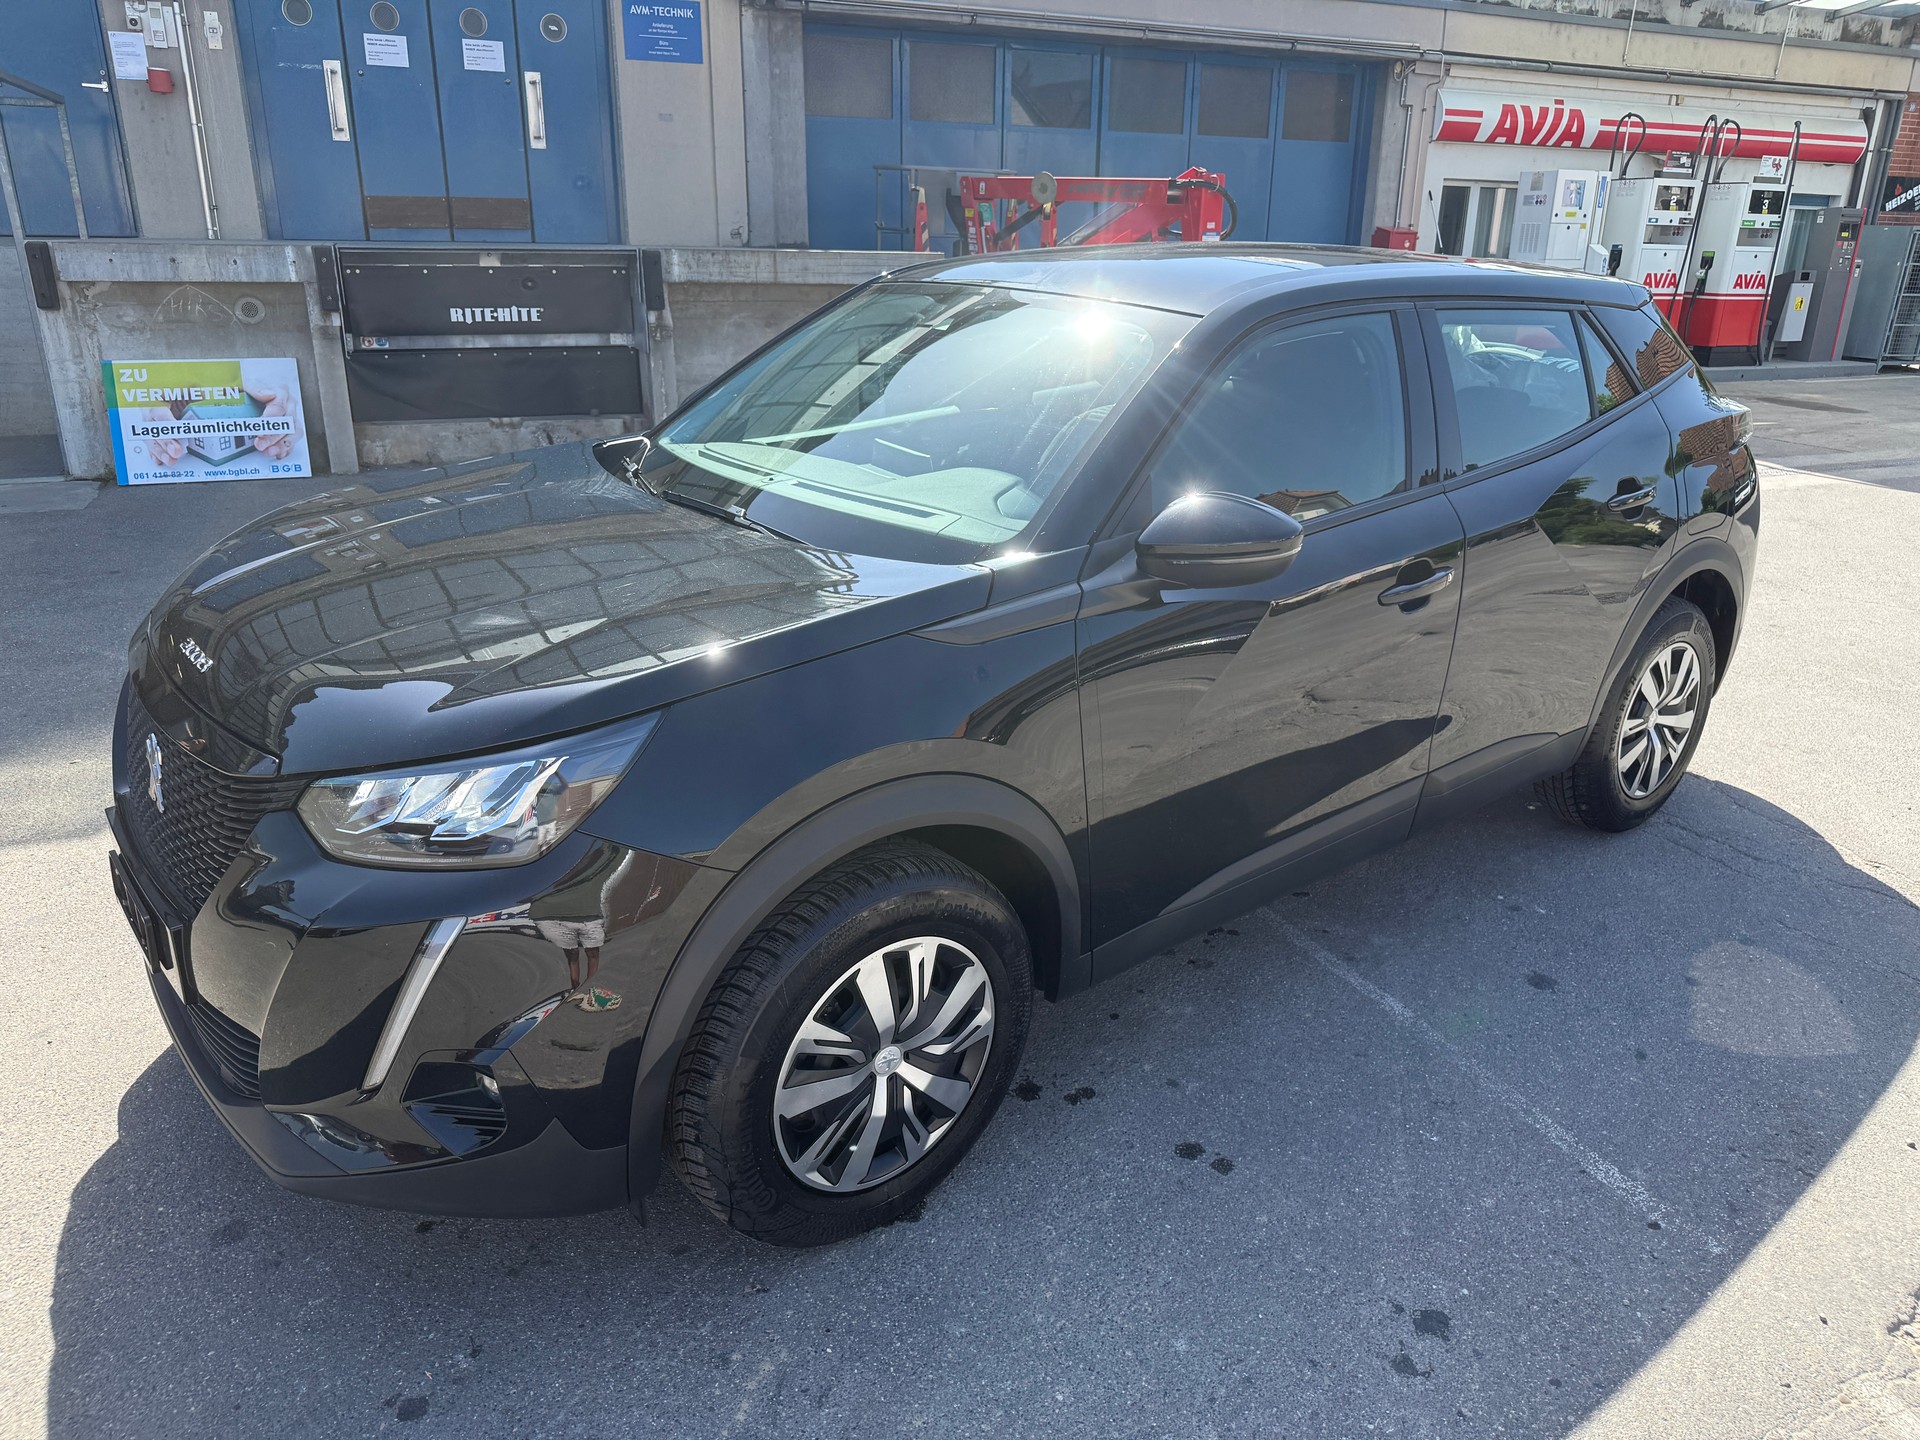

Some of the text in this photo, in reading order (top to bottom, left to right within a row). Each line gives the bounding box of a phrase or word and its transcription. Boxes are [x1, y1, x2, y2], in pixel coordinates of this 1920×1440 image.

[629, 4, 694, 19] AVM-TECHNIK
[1484, 98, 1586, 148] AVIA
[1669, 195, 1678, 206] 2
[1762, 199, 1769, 210] 3
[1885, 184, 1920, 212] HEIZOE
[1642, 269, 1678, 289] AVIA
[1732, 270, 1767, 290] AVIA
[119, 368, 148, 383] ZU
[122, 386, 240, 403] VERMIETEN
[131, 419, 290, 439] Lagerräumlichkeiten
[204, 467, 260, 478] www.bgbl.ch
